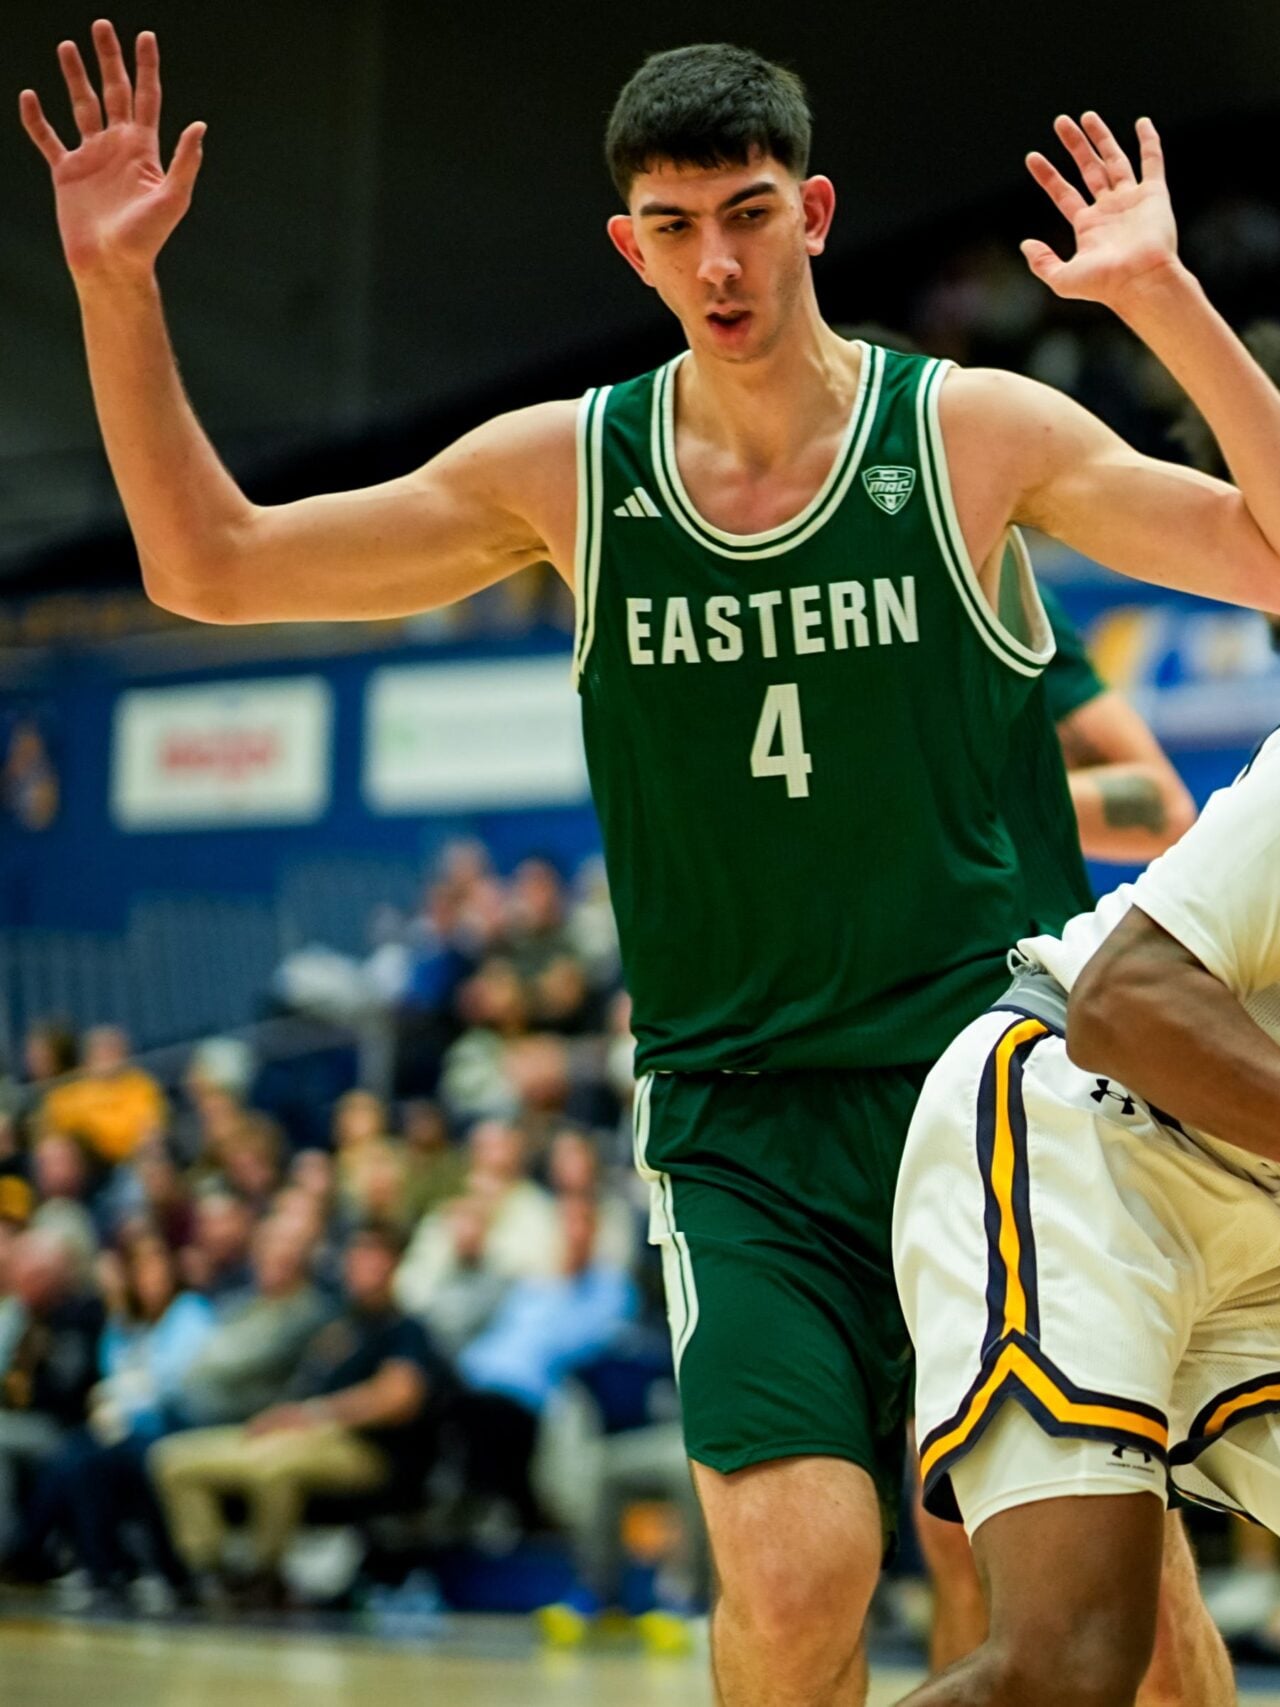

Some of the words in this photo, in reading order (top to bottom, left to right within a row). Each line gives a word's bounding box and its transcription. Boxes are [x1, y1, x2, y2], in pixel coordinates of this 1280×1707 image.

[868, 480, 911, 493] MAC
[626, 576, 920, 665] EASTERN
[750, 683, 813, 798] 4
